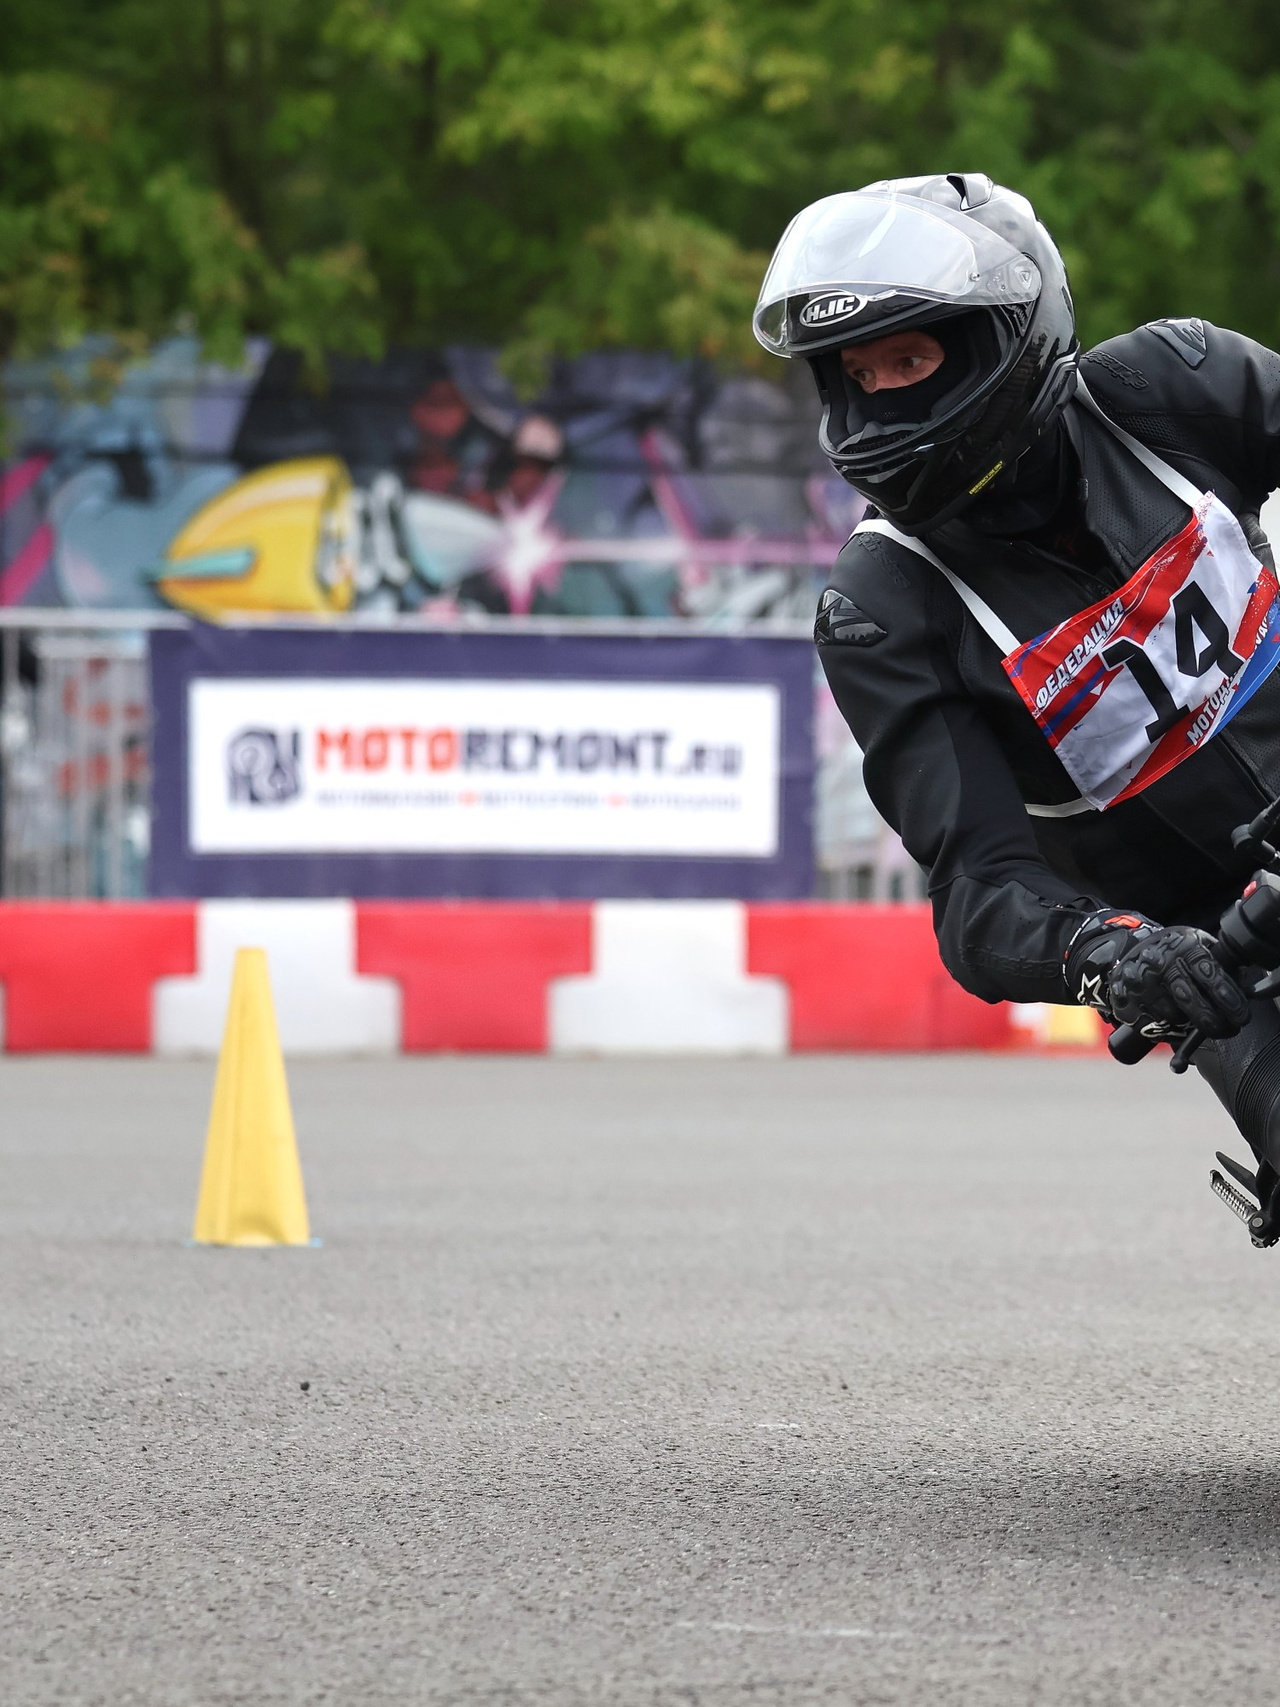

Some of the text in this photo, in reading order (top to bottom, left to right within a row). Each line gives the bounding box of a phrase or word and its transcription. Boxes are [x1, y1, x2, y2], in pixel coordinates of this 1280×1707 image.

[805, 295, 856, 323] HJC
[1033, 597, 1127, 711] ФЕДЕРАЦИЯ
[1099, 580, 1245, 744] 14
